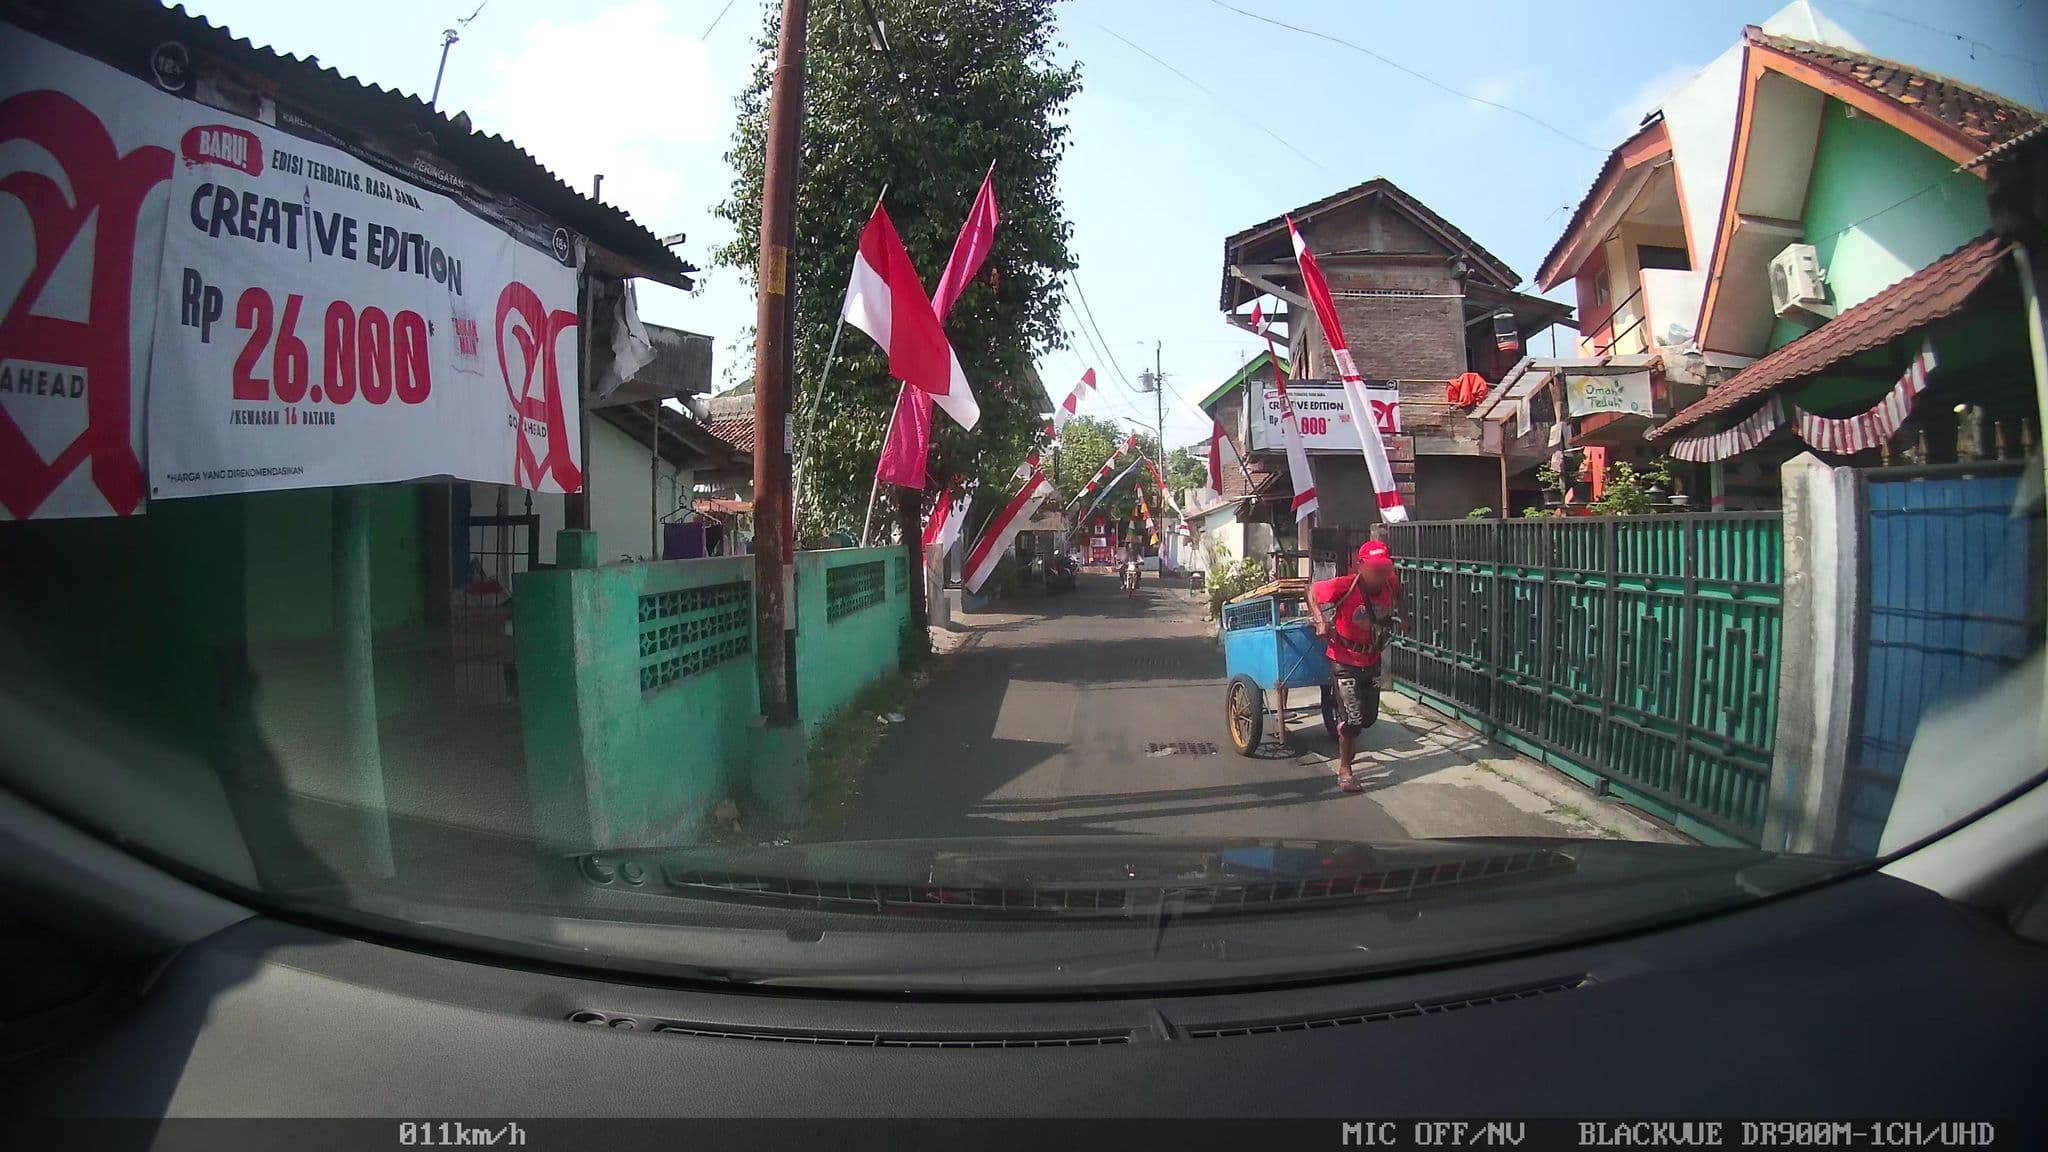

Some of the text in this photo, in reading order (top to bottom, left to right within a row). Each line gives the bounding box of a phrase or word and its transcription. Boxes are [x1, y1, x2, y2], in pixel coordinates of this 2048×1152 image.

[200, 130, 248, 169] BARU!
[271, 149, 303, 176] EDISI
[306, 159, 363, 192] TERBATAS.
[365, 177, 393, 201] RASA
[190, 182, 463, 296] CREATIVE EDITION
[181, 267, 224, 344] Rp
[0, 366, 86, 398] AHEAD
[284, 406, 298, 425] 16
[1310, 401, 1344, 411] EDITION
[523, 422, 547, 438] AHEAD
[203, 469, 226, 480] YANG
